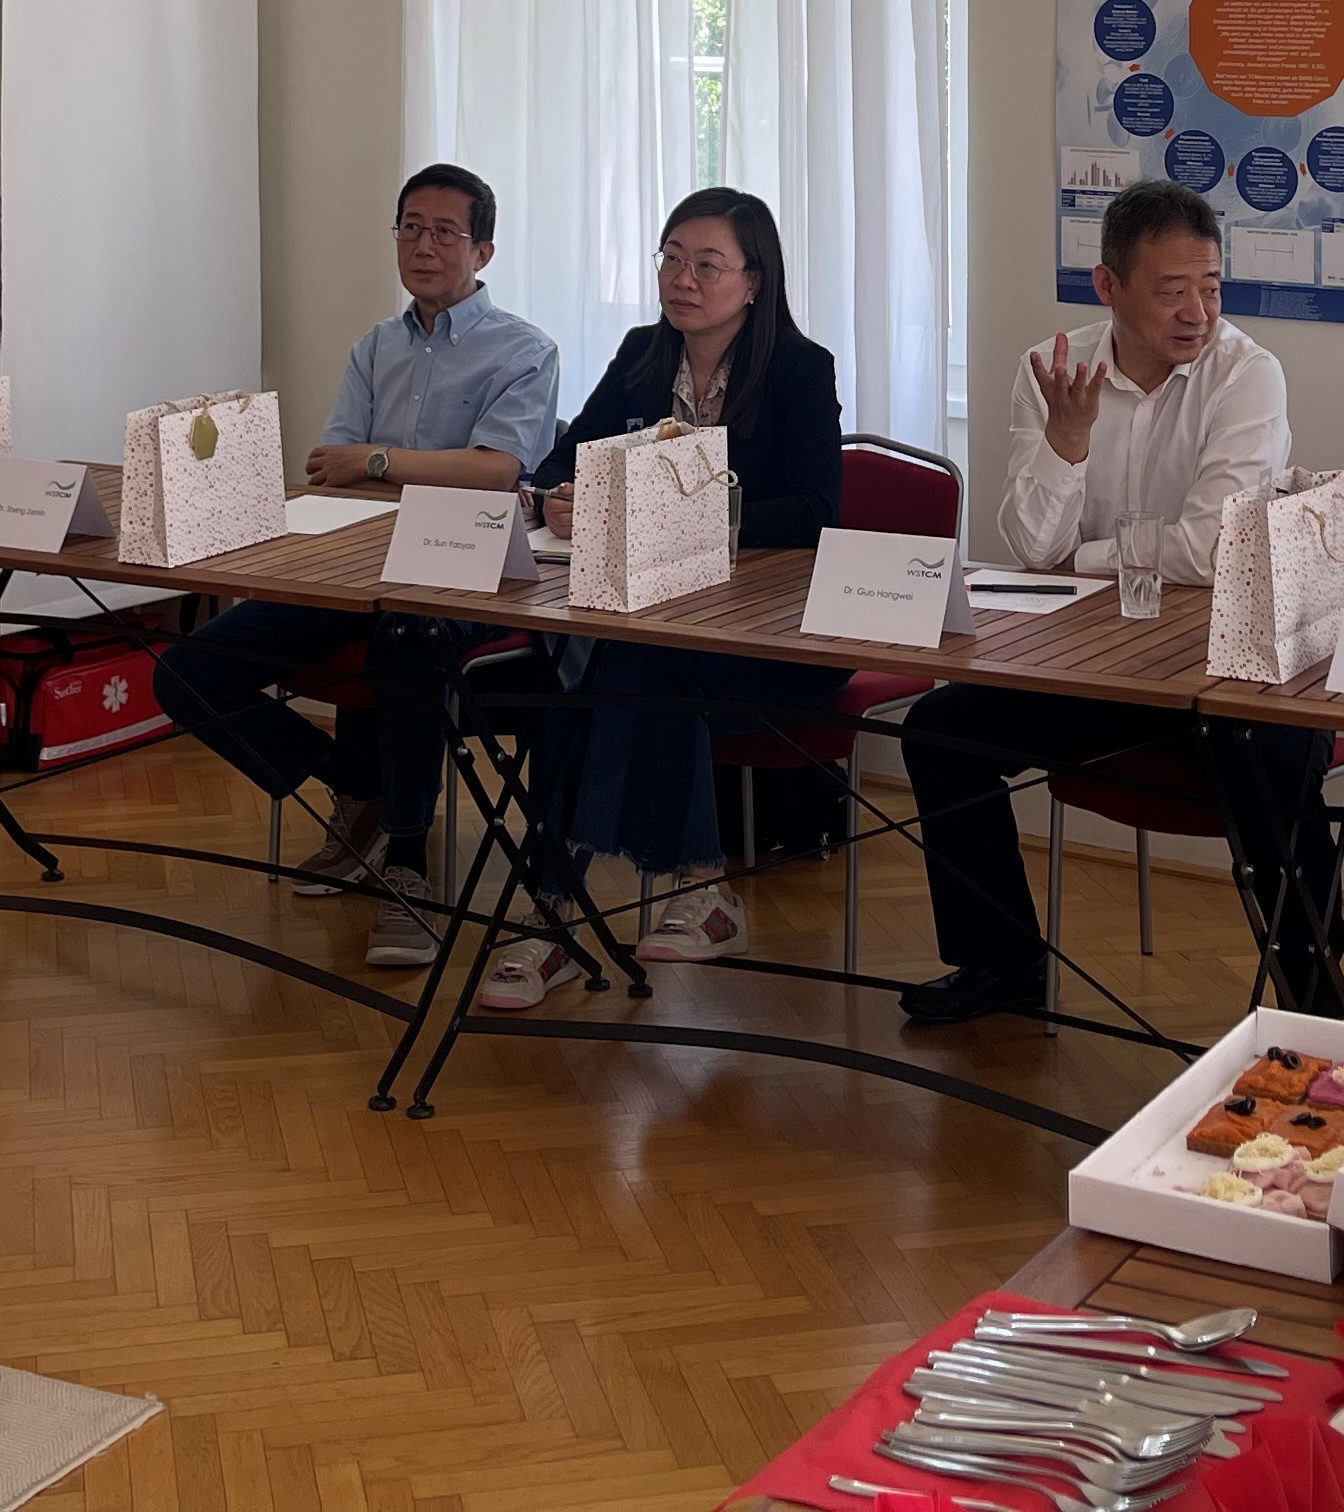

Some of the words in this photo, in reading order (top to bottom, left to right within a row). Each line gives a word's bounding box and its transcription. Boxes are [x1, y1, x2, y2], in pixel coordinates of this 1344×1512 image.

[474, 521, 505, 530] WSTCM
[423, 538, 432, 546] Dr.
[434, 539, 447, 547] Sun
[906, 569, 942, 579] WSTCM
[857, 587, 875, 597] Guo
